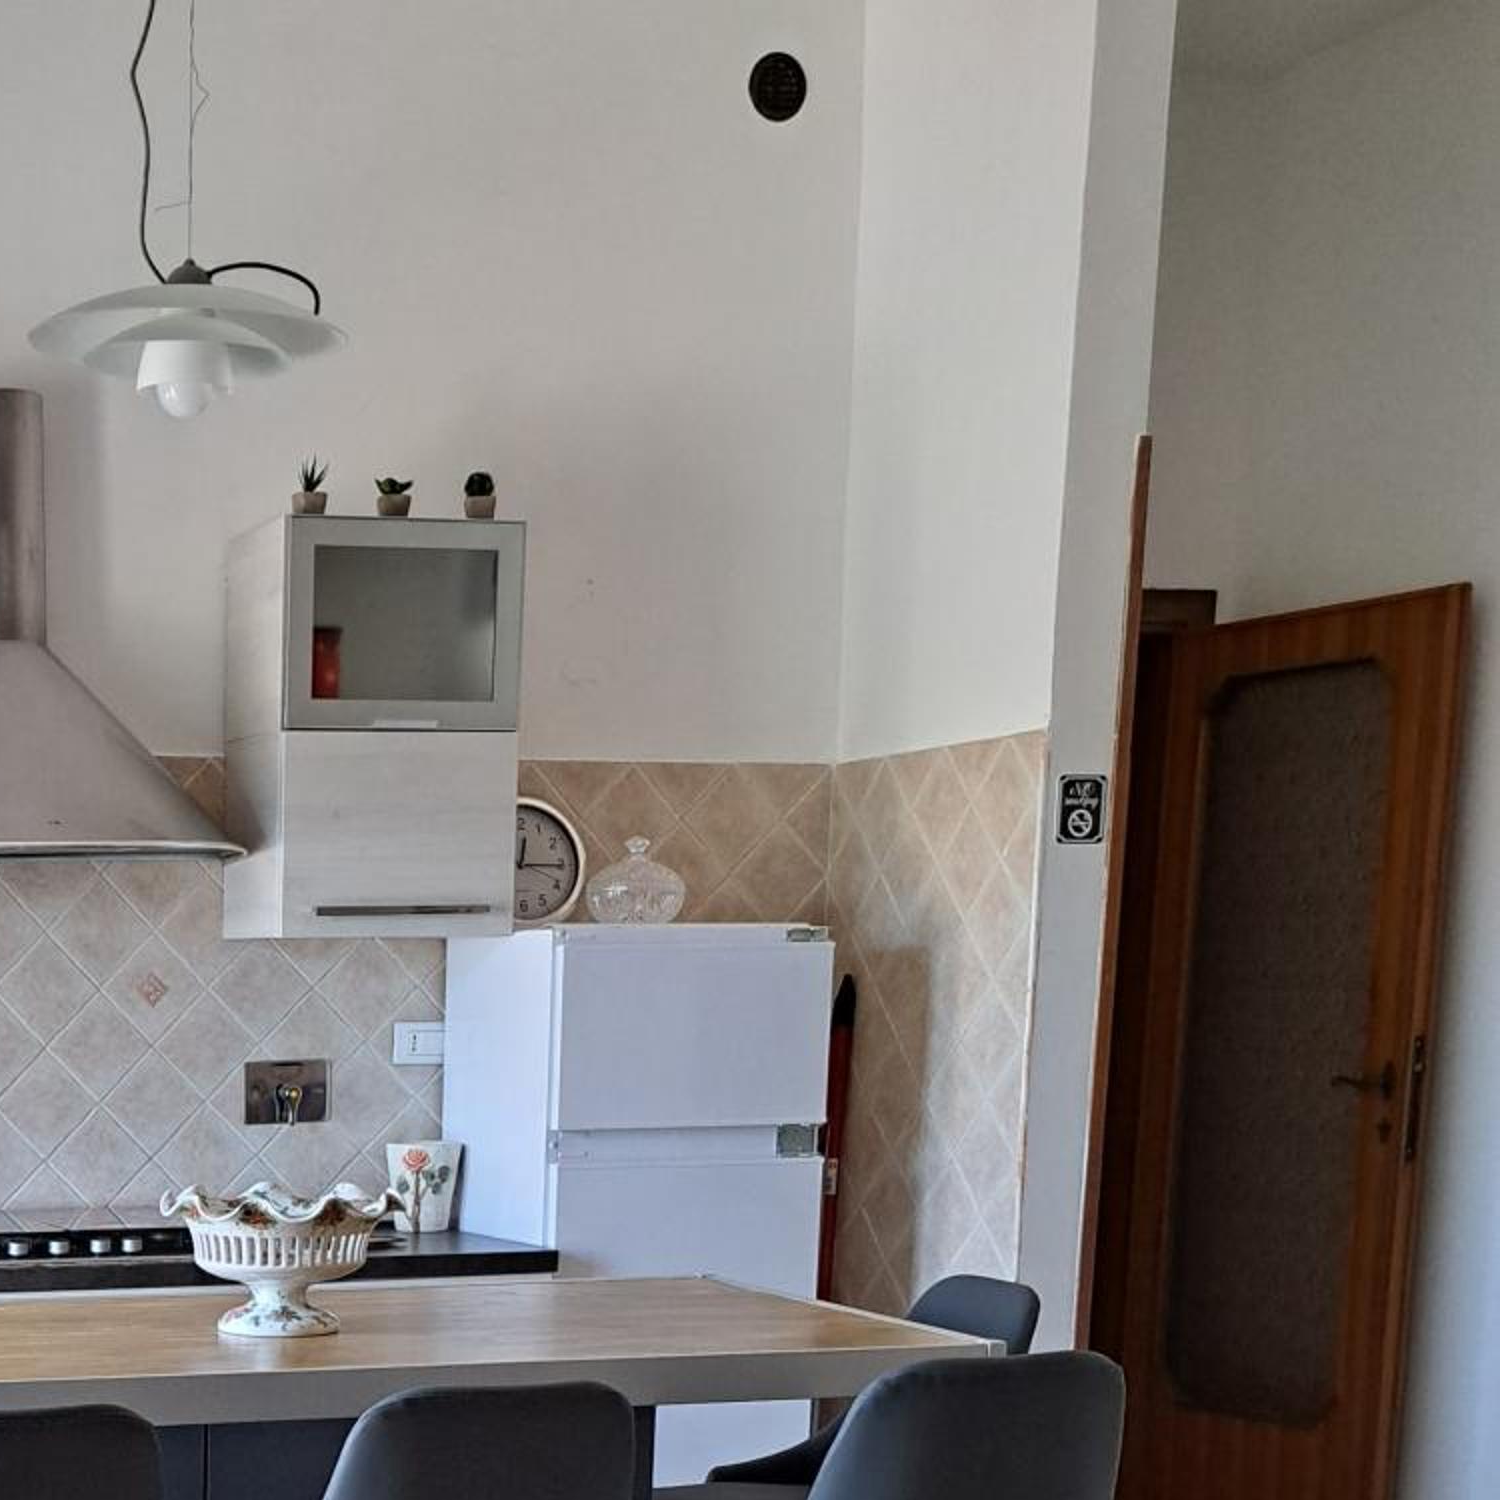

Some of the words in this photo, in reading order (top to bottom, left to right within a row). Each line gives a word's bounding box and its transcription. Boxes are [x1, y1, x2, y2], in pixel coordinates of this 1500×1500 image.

[549, 837, 557, 850] 2
[520, 900, 529, 913] 6
[538, 894, 547, 907] 5
